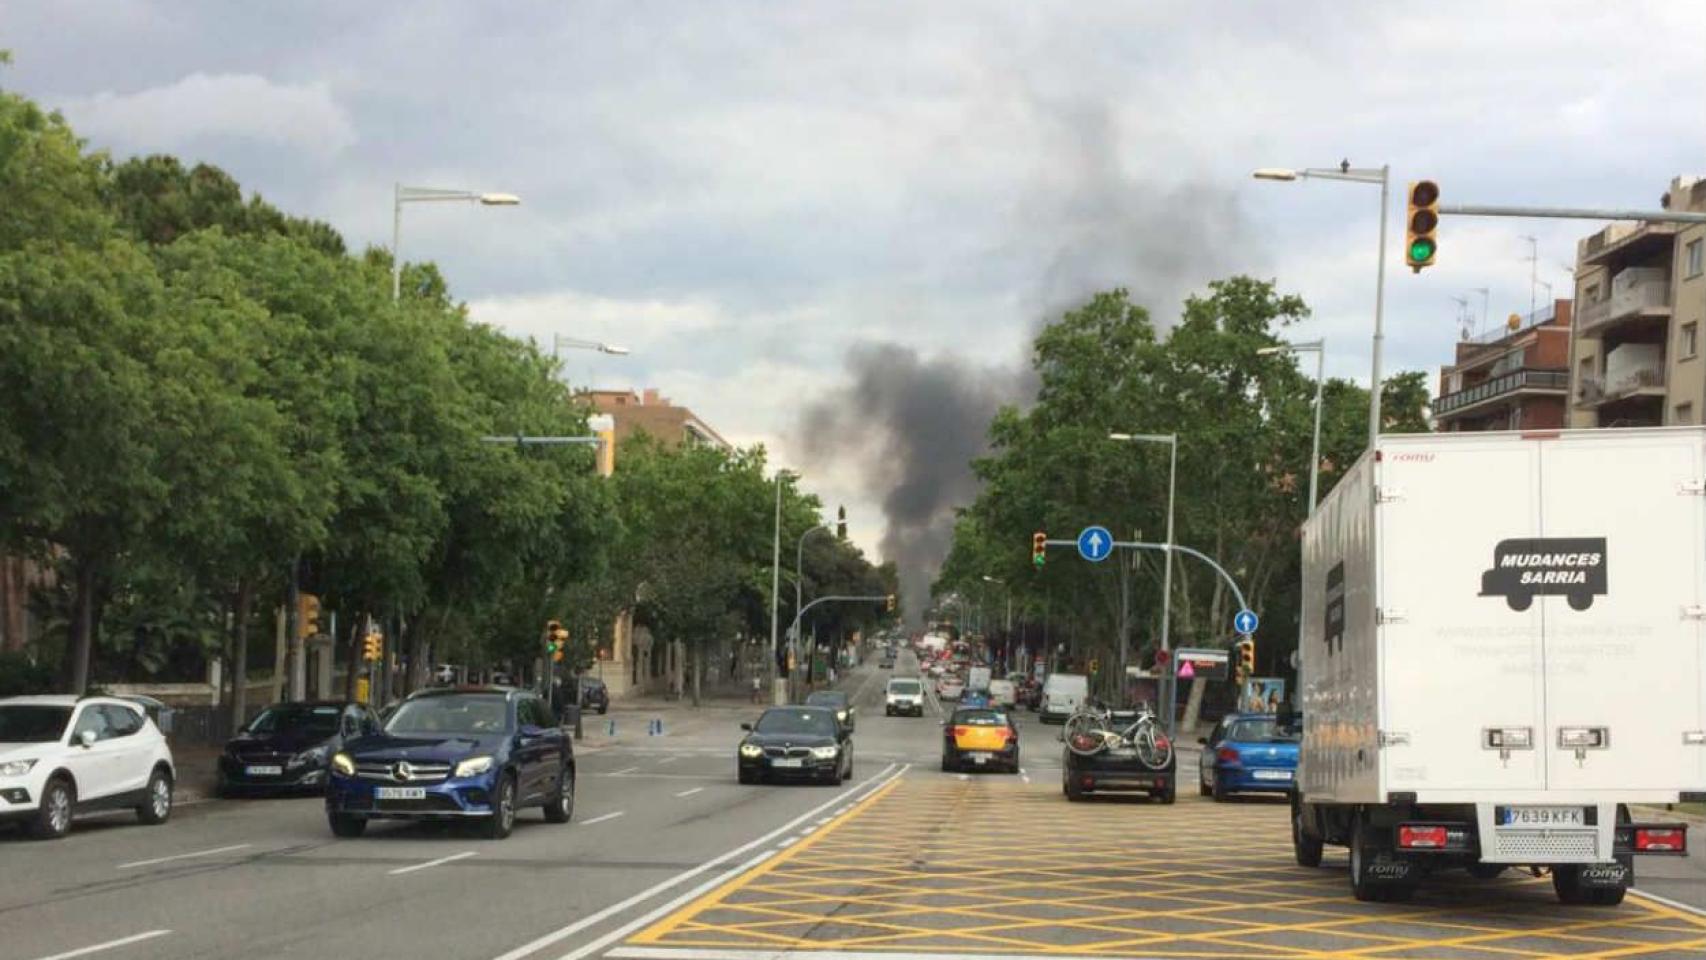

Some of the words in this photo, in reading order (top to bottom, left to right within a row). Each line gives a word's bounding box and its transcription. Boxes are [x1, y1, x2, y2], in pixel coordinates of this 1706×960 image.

[1500, 552, 1602, 567] MUDANCES
[1520, 571, 1586, 584] SARRIA
[1512, 808, 1550, 823] 7639
[1552, 808, 1580, 823] KFK
